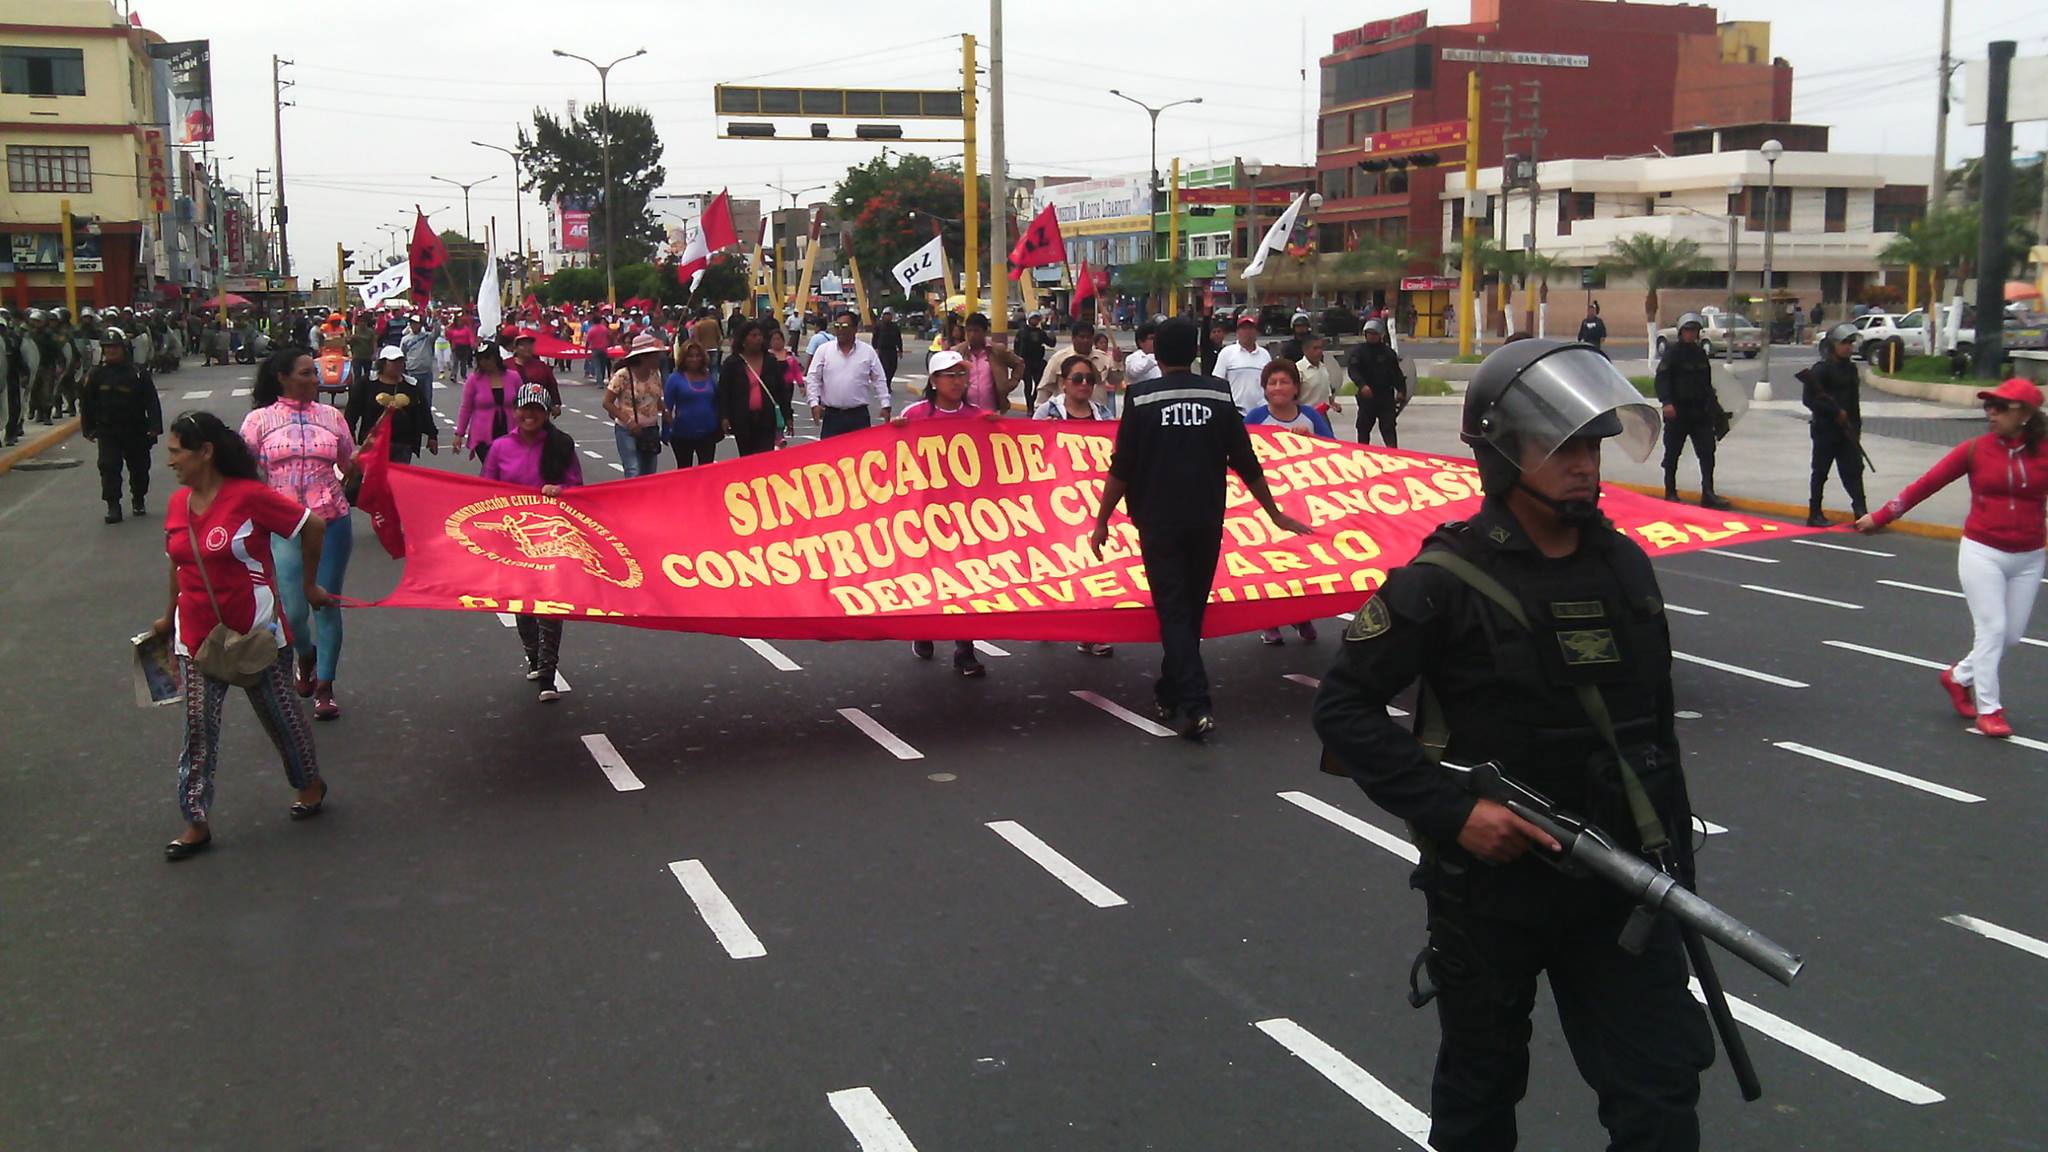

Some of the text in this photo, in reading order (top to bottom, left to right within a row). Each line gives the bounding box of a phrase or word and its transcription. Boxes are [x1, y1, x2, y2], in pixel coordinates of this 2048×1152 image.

[1160, 402, 1213, 426] FTCCP
[511, 494, 540, 507] CIVIL
[724, 432, 982, 537] SINDICATO
[988, 432, 1057, 485] DE
[661, 494, 1046, 590] CONSTRUCCION
[830, 521, 1143, 616] DEPARTAMEN
